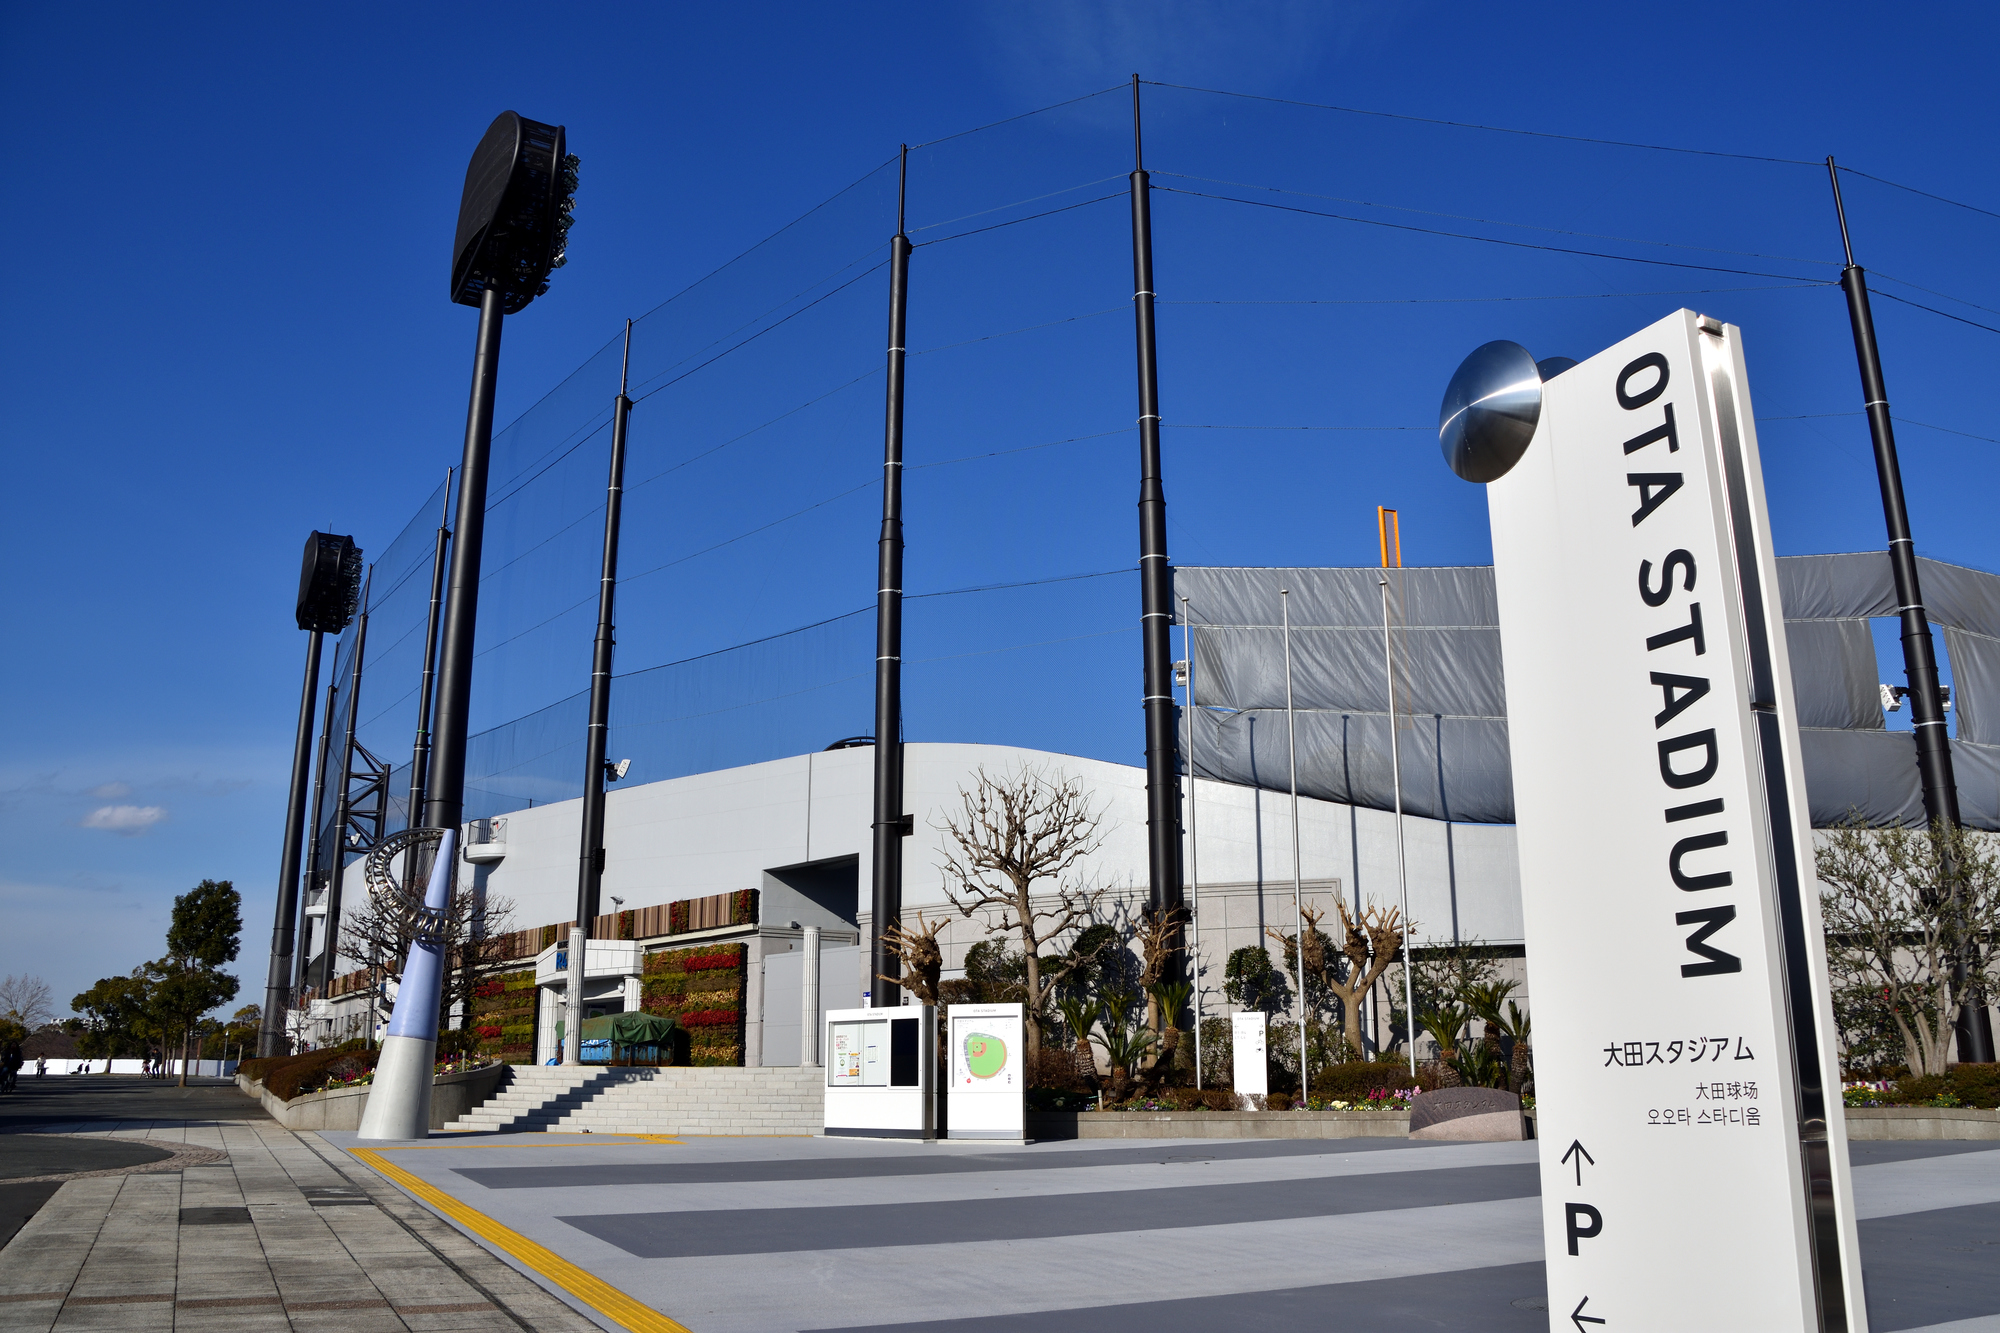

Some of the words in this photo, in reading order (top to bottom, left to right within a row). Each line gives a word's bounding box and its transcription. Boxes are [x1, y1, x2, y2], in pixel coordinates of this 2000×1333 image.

[1615, 351, 1685, 528] OTA
[1638, 548, 1742, 979] STADIUM
[556, 952, 568, 969] R4
[1603, 1036, 1755, 1068] 大田スタジアム
[1695, 1081, 1759, 1101] 大田球场
[1647, 1107, 1692, 1126] 오오타
[1697, 1106, 1761, 1127] 스타디움
[1564, 1202, 1603, 1257] P
